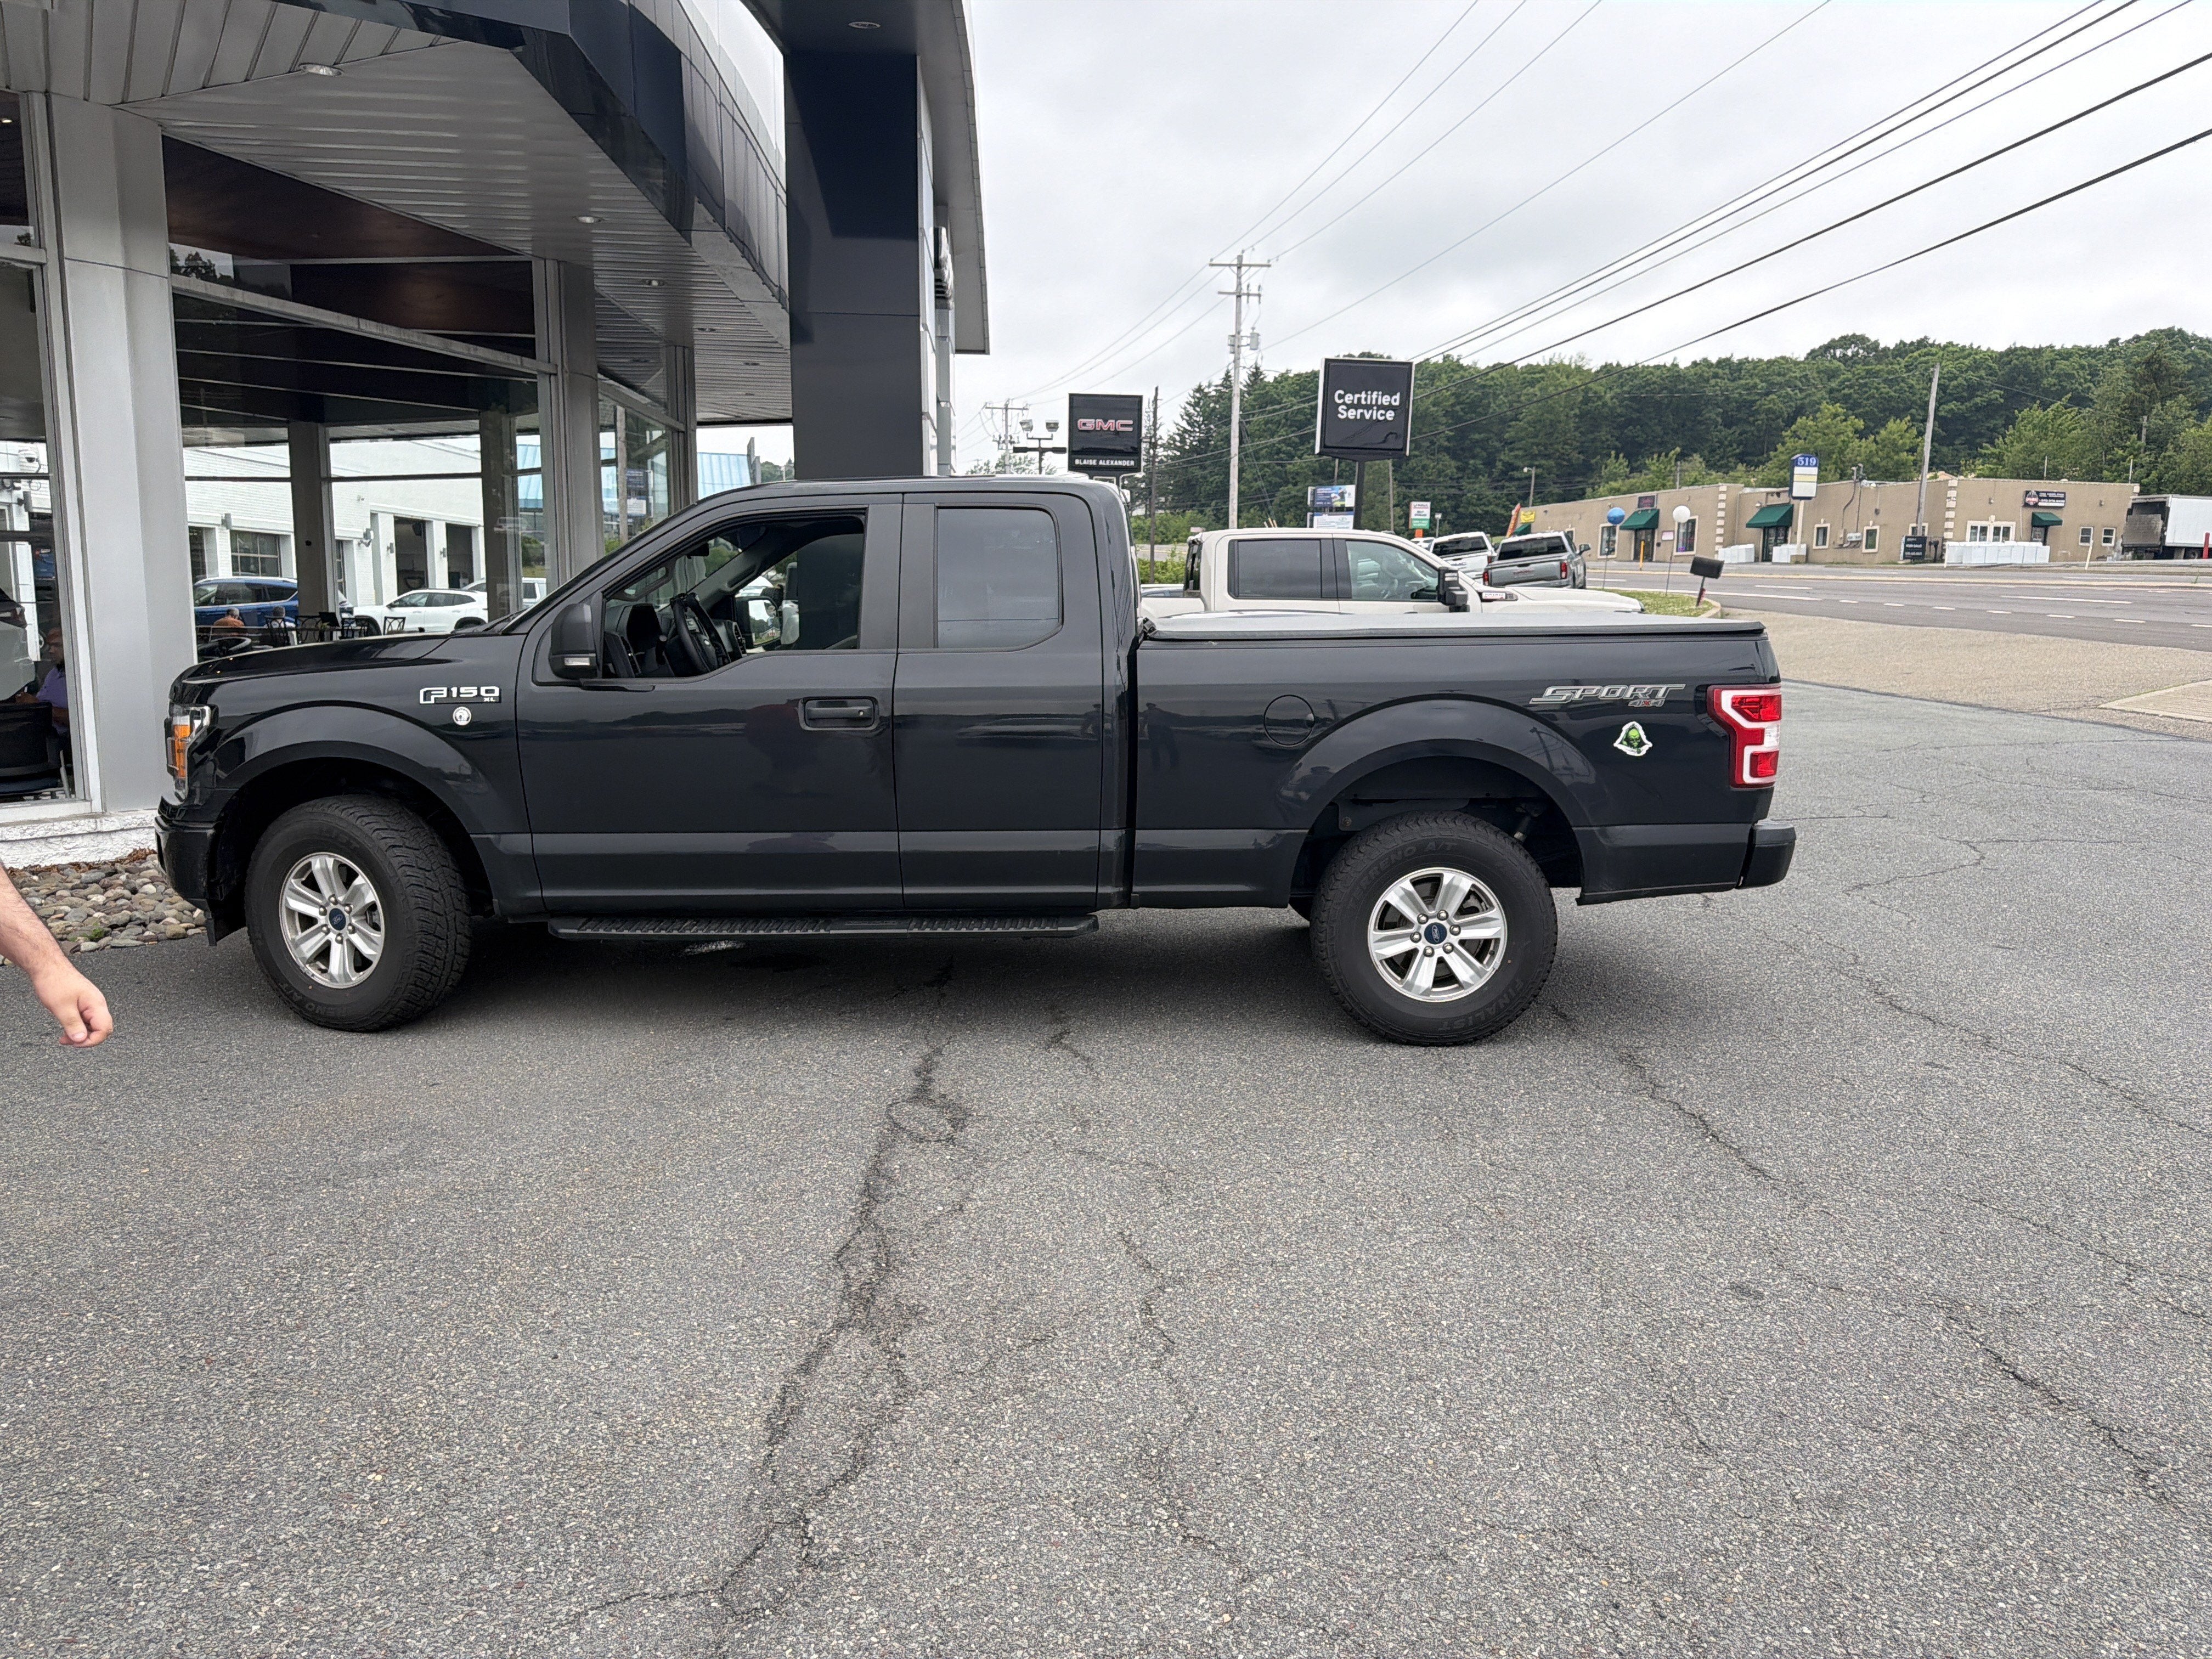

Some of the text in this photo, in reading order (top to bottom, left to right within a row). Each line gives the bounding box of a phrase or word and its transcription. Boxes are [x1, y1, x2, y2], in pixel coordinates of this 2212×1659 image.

[1334, 390, 1401, 406] Certified
[1337, 405, 1395, 421] Service
[1077, 419, 1133, 431] GMC
[1797, 456, 1816, 466] 519
[1529, 684, 1686, 704] SPORT
[1423, 841, 1457, 853] A/T
[1439, 979, 1523, 1030] FINALIST
